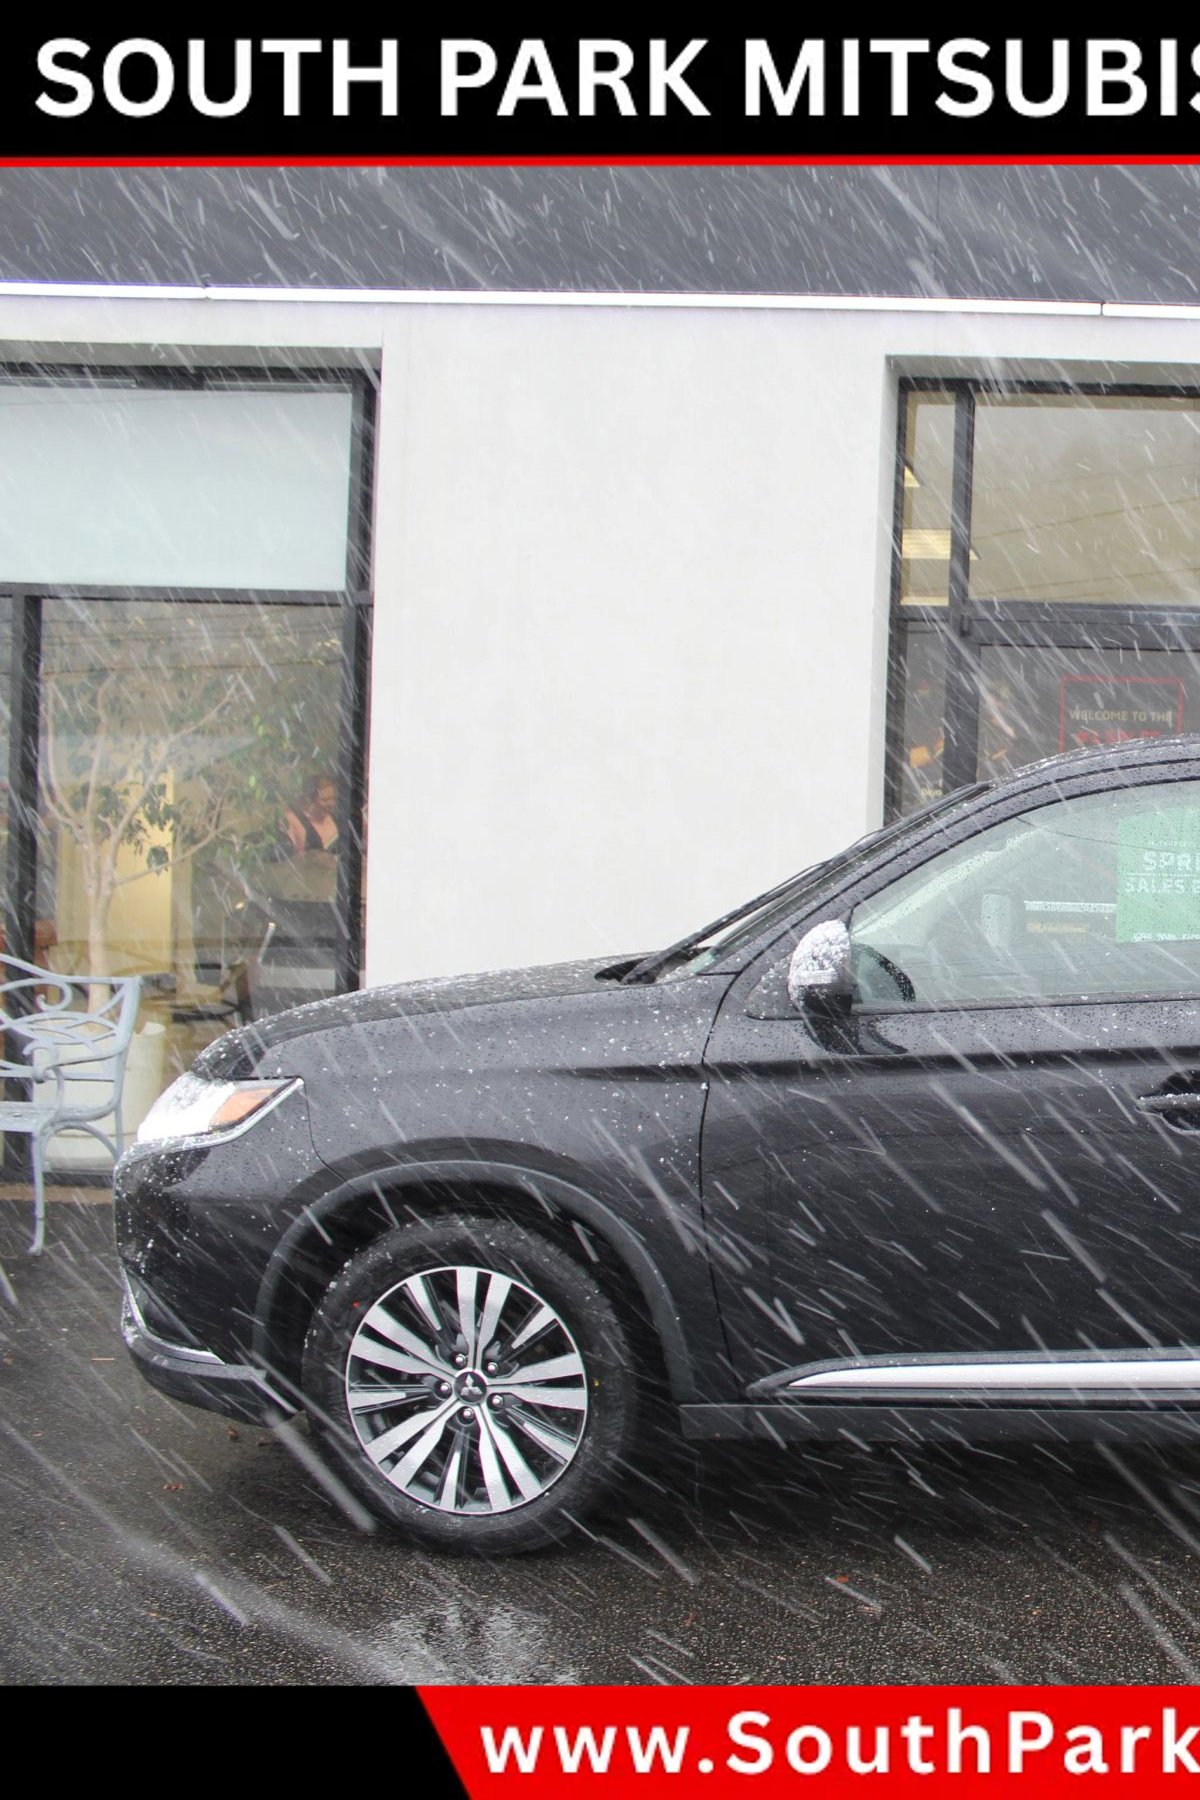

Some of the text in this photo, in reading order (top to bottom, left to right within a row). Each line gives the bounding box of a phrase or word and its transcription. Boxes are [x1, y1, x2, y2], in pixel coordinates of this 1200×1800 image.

[1069, 709, 1173, 723] WELCOME TO THE
[1125, 877, 1185, 894] SALES
